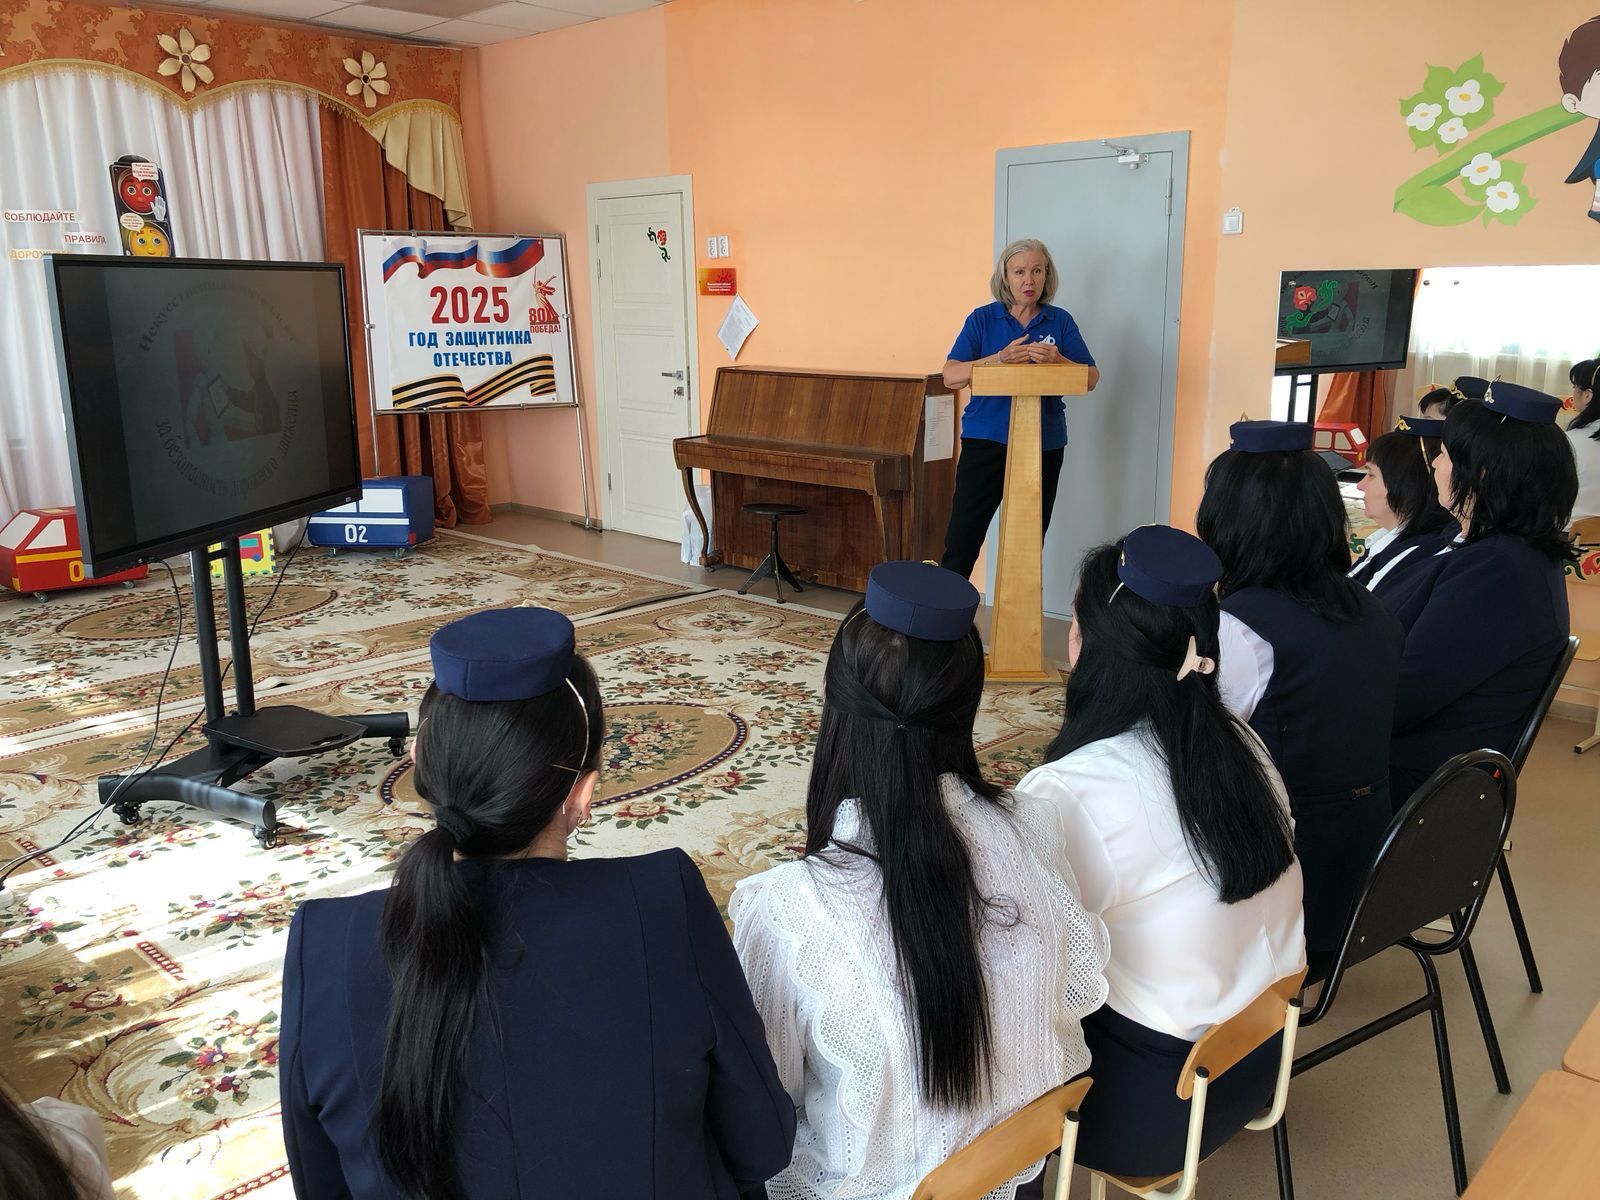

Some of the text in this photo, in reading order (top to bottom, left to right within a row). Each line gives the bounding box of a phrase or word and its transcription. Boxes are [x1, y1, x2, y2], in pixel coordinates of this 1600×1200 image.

[4, 211, 76, 223] СОБЛЮДАЙТЕ
[64, 234, 107, 245] ПРАВИЛА
[429, 286, 510, 324] 2025
[528, 307, 546, 324] 80
[529, 324, 562, 335] ПОБЕДА!
[408, 330, 533, 348] ГОД ЗАЩИТНИКА
[433, 351, 513, 367] ОТЕЧЕСТВА
[344, 524, 369, 543] 02
[69, 560, 85, 582] 0
